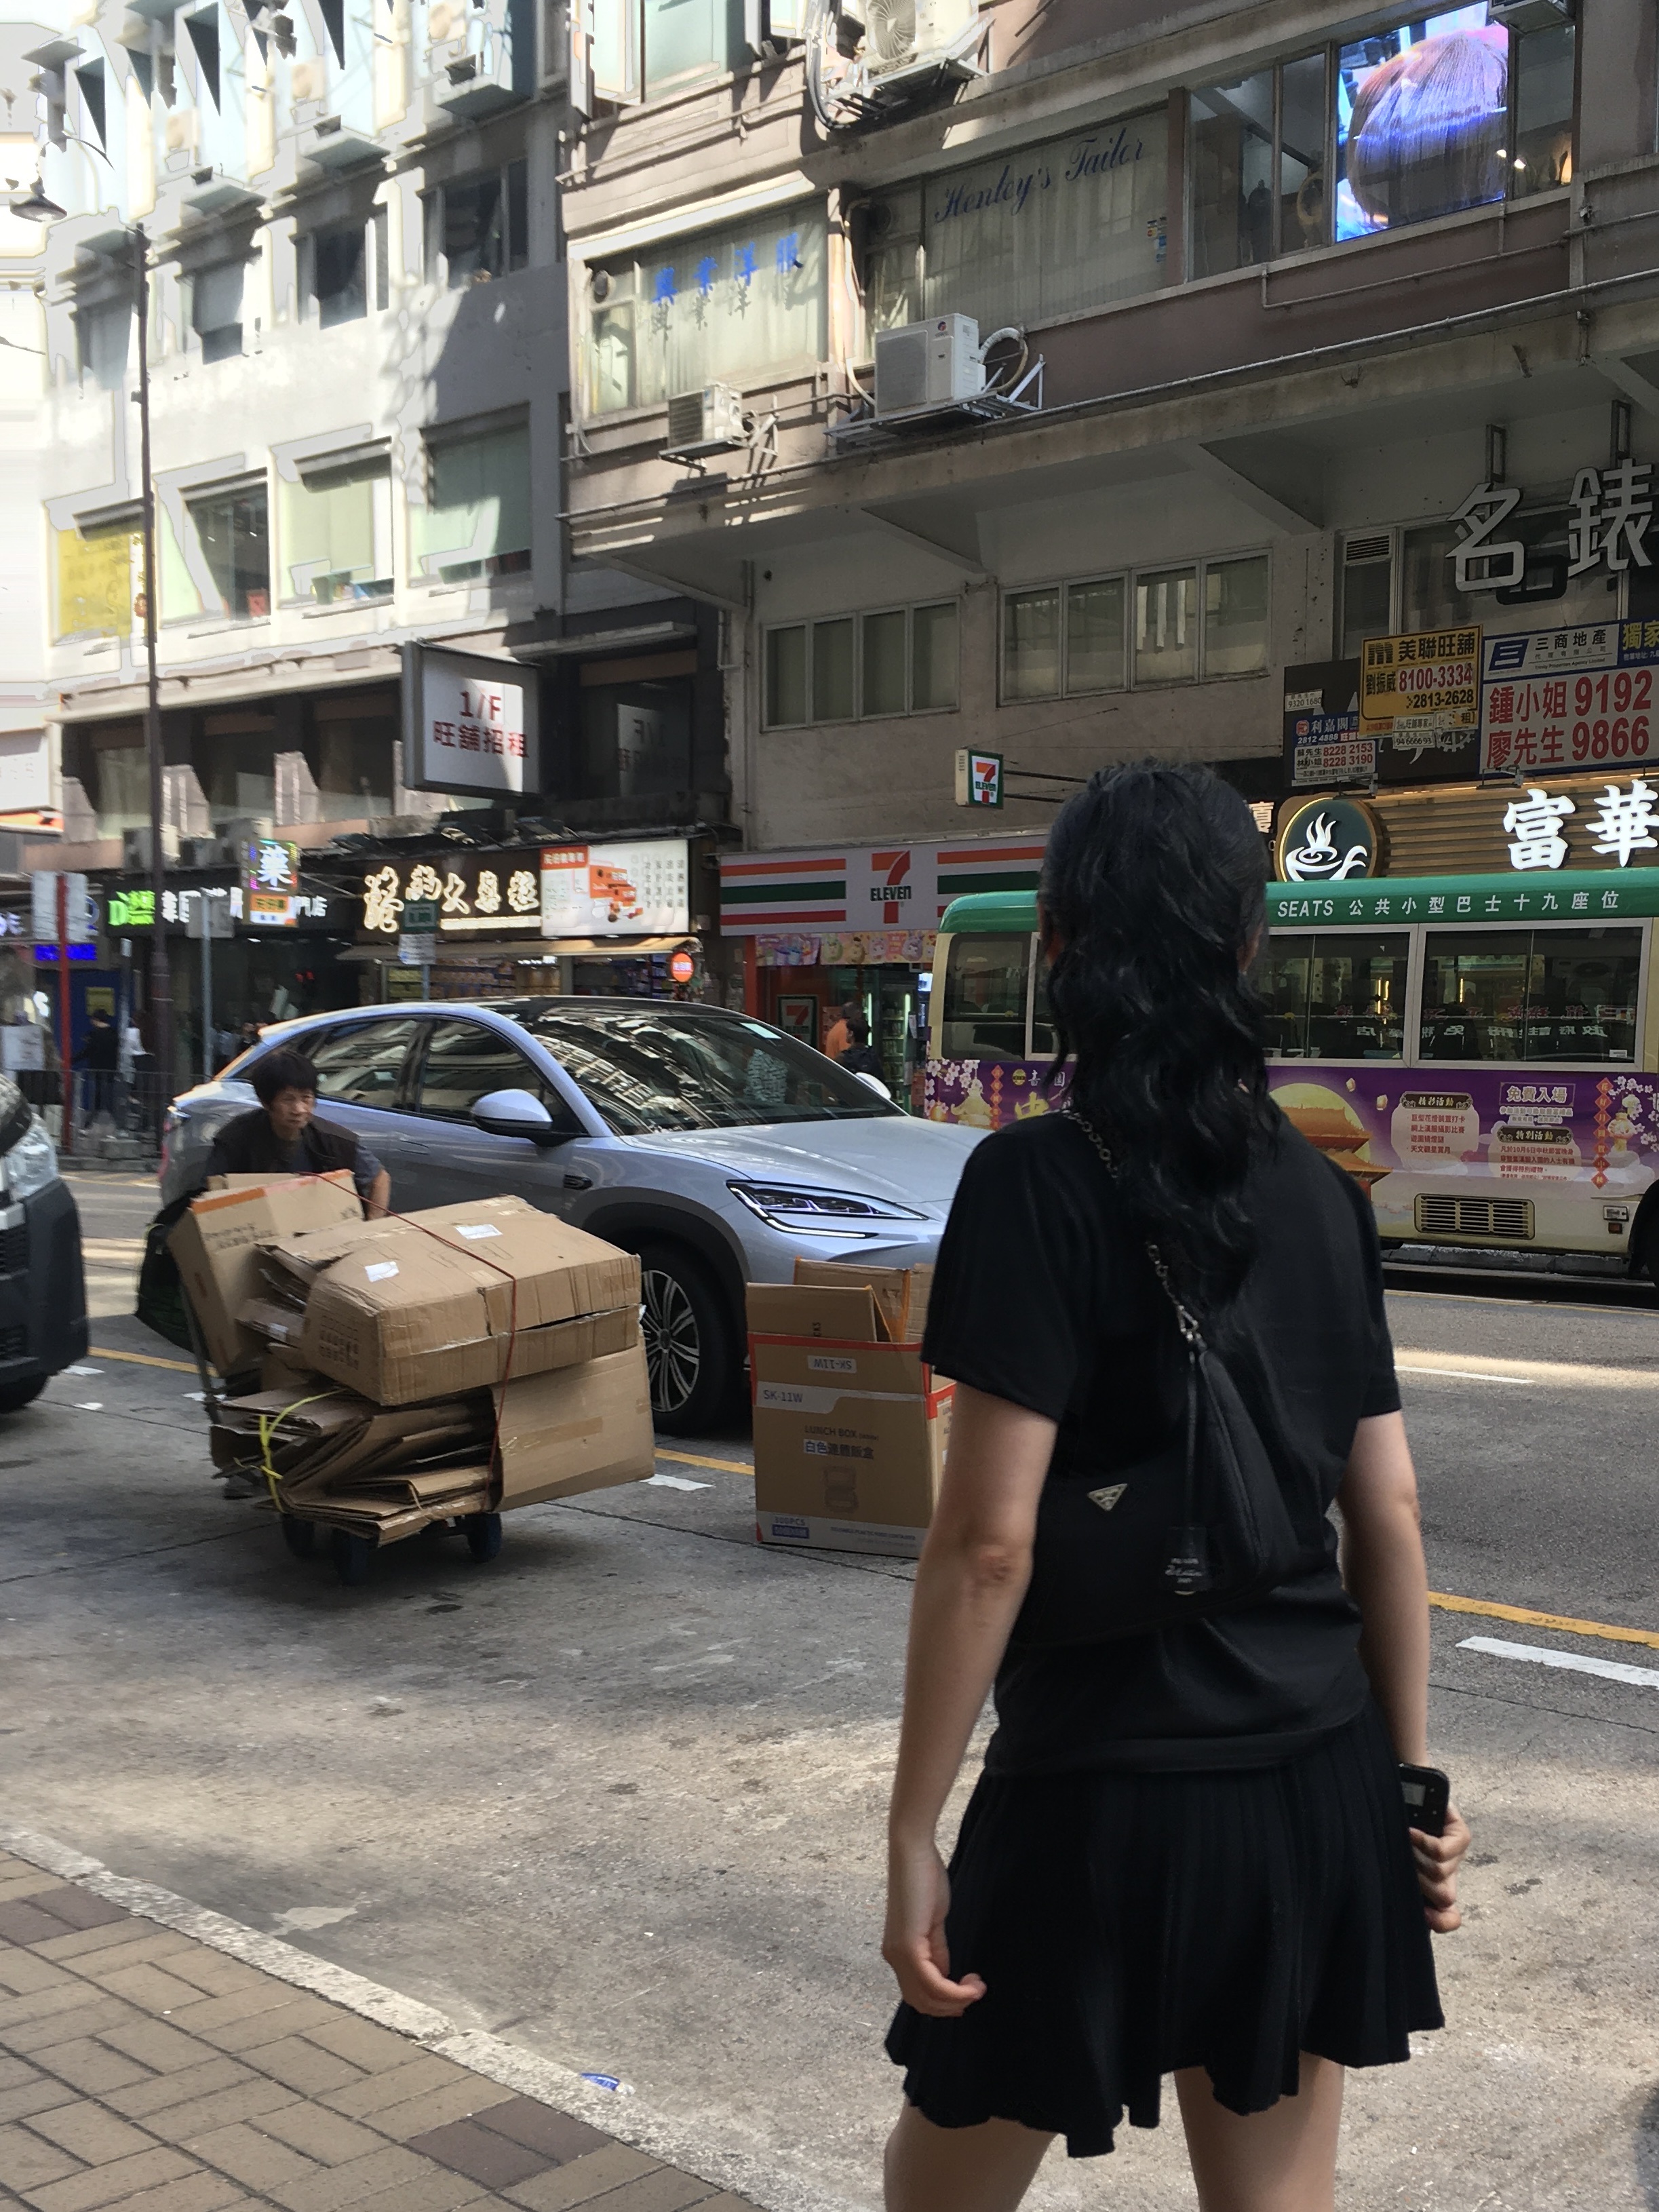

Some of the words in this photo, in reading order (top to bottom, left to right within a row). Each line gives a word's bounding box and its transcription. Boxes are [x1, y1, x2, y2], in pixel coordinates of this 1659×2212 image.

[935, 164, 1051, 224] Henley's
[1065, 127, 1144, 182] Tailor
[1445, 458, 1654, 591] 名錶
[1398, 632, 1475, 661] 美聯旺舖
[1535, 629, 1606, 651] 三商地產
[1399, 662, 1473, 692] 8100-3334
[1413, 688, 1474, 708] 2813-2628
[1574, 670, 1652, 716] 9192
[459, 691, 501, 720] 1/F
[433, 720, 529, 758] 旺舖招租
[1297, 735, 1317, 744] 2812
[1318, 733, 1339, 742] 4888
[1323, 745, 1346, 757] 8228
[1349, 742, 1373, 754] 2153
[1487, 724, 1565, 769] 廖先生
[1572, 715, 1650, 761] 9866
[1323, 756, 1346, 768] 8228
[1349, 754, 1373, 765] 3190
[1503, 780, 1659, 870] 富華
[1278, 900, 1334, 918] SEATS
[1349, 891, 1620, 916] 公共小型巴士十九座位
[1418, 1096, 1454, 1106] 精彩活動
[1506, 1085, 1567, 1103] 免費入場
[1515, 1130, 1553, 1140] 特別活動
[814, 1358, 852, 1370] SK-11W
[763, 1390, 803, 1403] SK-11W
[804, 1425, 836, 1437] LUNCH
[838, 1427, 857, 1439] BOX
